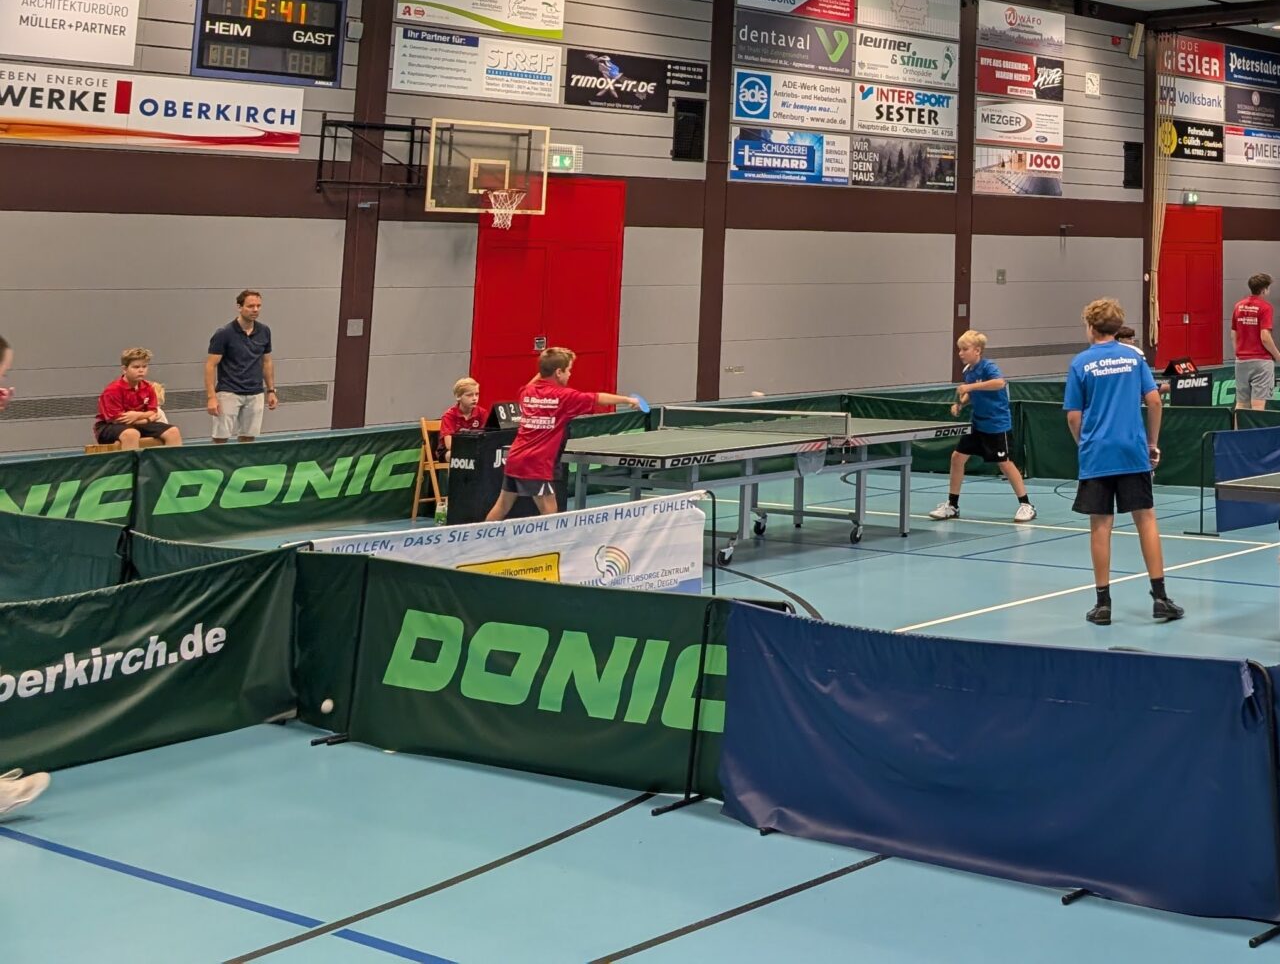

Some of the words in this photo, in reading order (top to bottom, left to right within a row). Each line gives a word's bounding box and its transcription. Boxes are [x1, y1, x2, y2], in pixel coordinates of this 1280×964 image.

[19, 14, 126, 36] MÜLLER+PARTNER
[205, 21, 251, 37] HEIM
[293, 30, 335, 45] GAST
[407, 30, 419, 38] Ihr
[421, 32, 450, 42] Partner
[452, 35, 466, 44] für:
[739, 25, 811, 50] dentaval
[487, 49, 554, 73] STREIF
[900, 51, 938, 70] stinus
[1229, 52, 1280, 76] Peterstaler
[47, 74, 109, 87] ENERGIE
[570, 74, 657, 94] TIMOX-IT.DE
[782, 80, 818, 91] ADE-Werk
[819, 84, 841, 94] GmbH
[739, 85, 768, 103] ade
[876, 87, 951, 108] INTERSPORT
[1178, 91, 1222, 108] Volksbank
[139, 98, 296, 126] OBERKIRCH
[773, 112, 805, 122] Offenburg
[875, 104, 939, 126] SESTER
[981, 113, 1022, 127] MEZGER
[762, 143, 808, 155] SCHLOSSEREI
[853, 142, 869, 151] WIR
[744, 144, 808, 170] LIENHARD
[853, 151, 879, 162] BAUEN
[1029, 154, 1061, 169] JOCO
[853, 162, 873, 172] DEIN
[852, 172, 875, 182] HAUS
[1099, 356, 1138, 367] Offenburg
[1091, 365, 1132, 377] Tischtennis
[1176, 377, 1209, 389] DONIC
[498, 406, 507, 420] 8
[509, 404, 515, 414] 2
[934, 427, 969, 437] DONIC
[450, 458, 475, 470] JOOLA
[618, 457, 658, 468] DONIC
[670, 454, 717, 468] DONIC
[152, 448, 423, 516] DONIC
[403, 533, 441, 548] DASS
[447, 530, 468, 543] SIE
[476, 526, 507, 539] SICH
[512, 522, 550, 536] WOHL
[555, 518, 569, 530] IN
[574, 512, 609, 527] IHRER
[614, 506, 647, 521] HAUT
[545, 564, 553, 572] in
[627, 572, 660, 584] FÜRSORGE
[660, 566, 690, 578] ZENTRUM
[657, 578, 679, 588] DEGEN
[382, 608, 728, 733] DONIC
